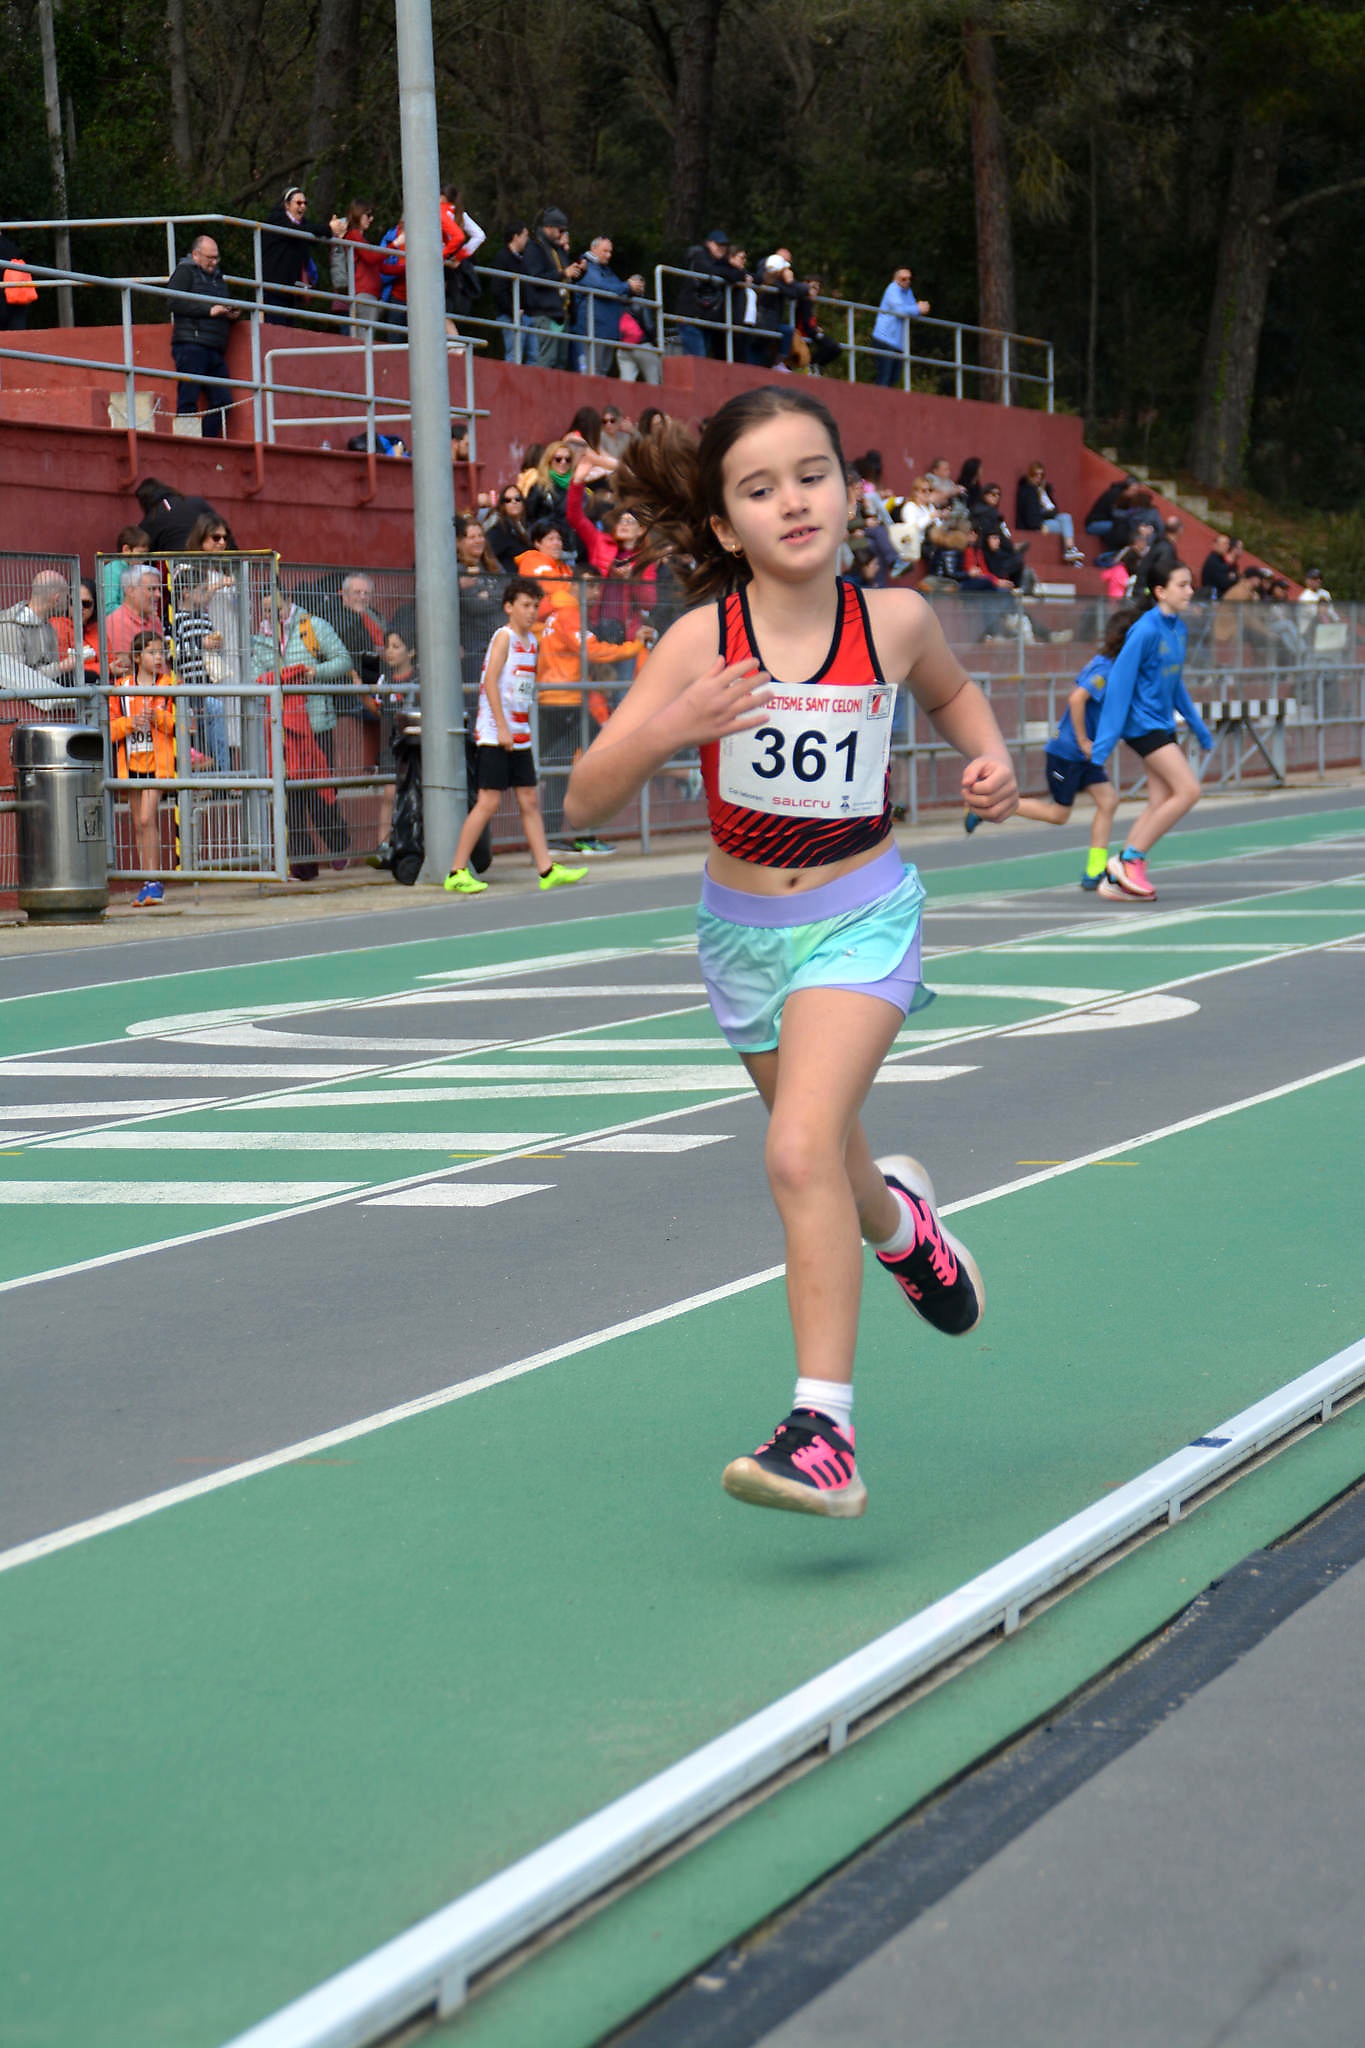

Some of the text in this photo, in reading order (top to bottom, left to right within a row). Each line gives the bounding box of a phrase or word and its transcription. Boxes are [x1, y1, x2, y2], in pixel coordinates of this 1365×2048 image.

[805, 697, 830, 713] SANT
[832, 699, 863, 713] CELONI
[751, 727, 858, 783] 361
